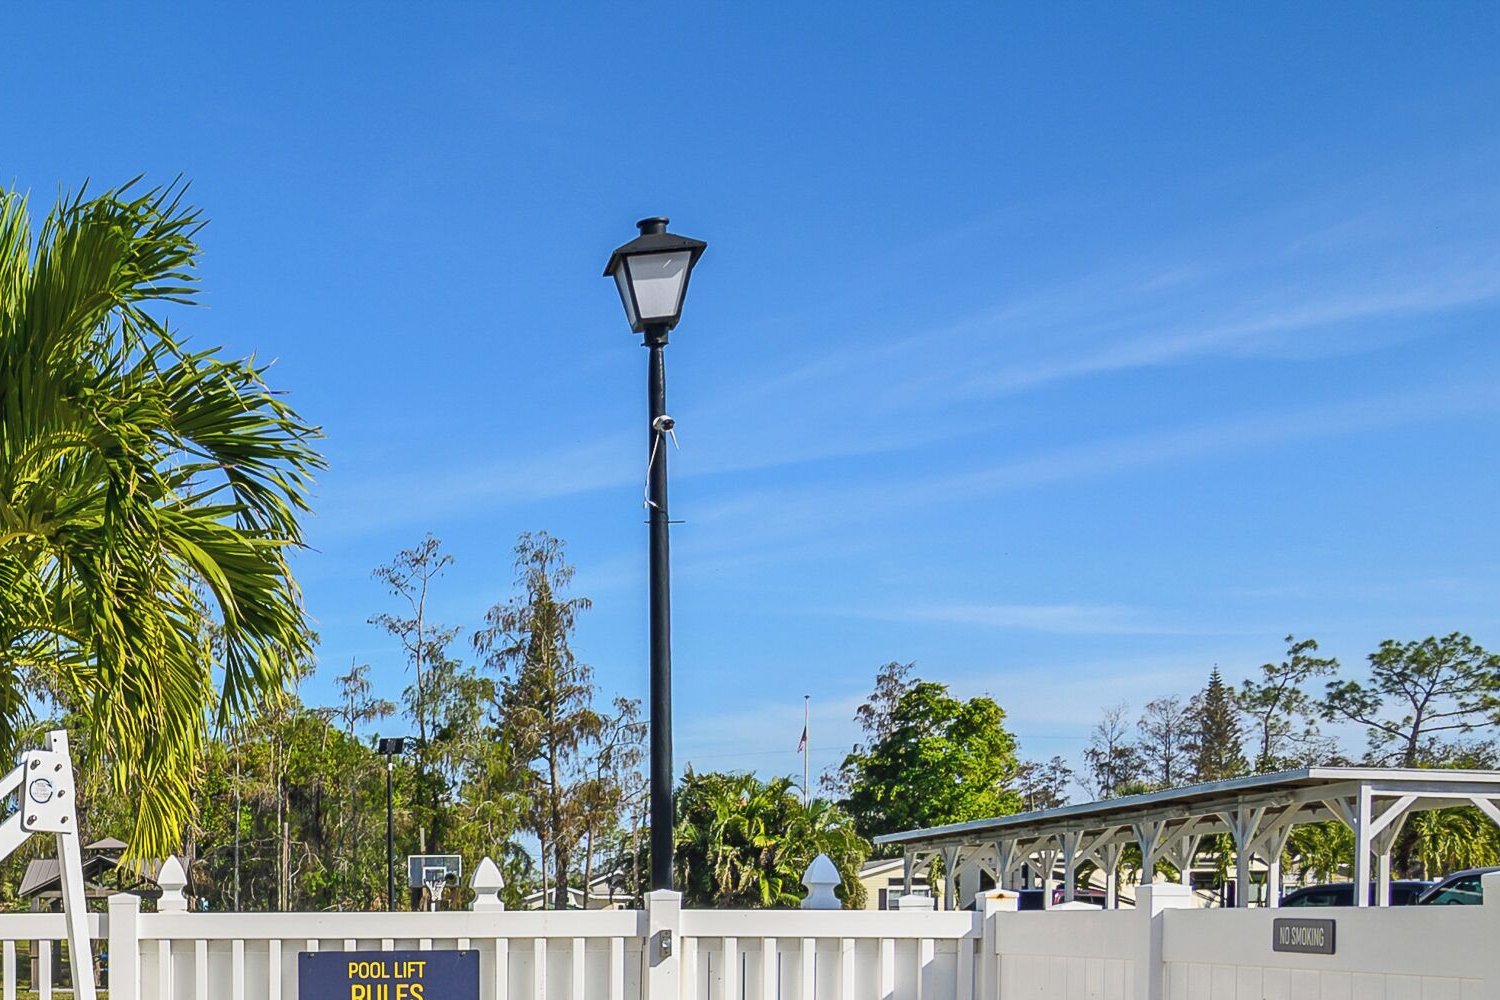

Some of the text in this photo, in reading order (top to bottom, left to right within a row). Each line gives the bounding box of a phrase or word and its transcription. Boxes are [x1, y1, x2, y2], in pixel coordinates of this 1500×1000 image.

[1280, 926, 1324, 947] NO SMOKING
[348, 961, 426, 979] POOL LIFT
